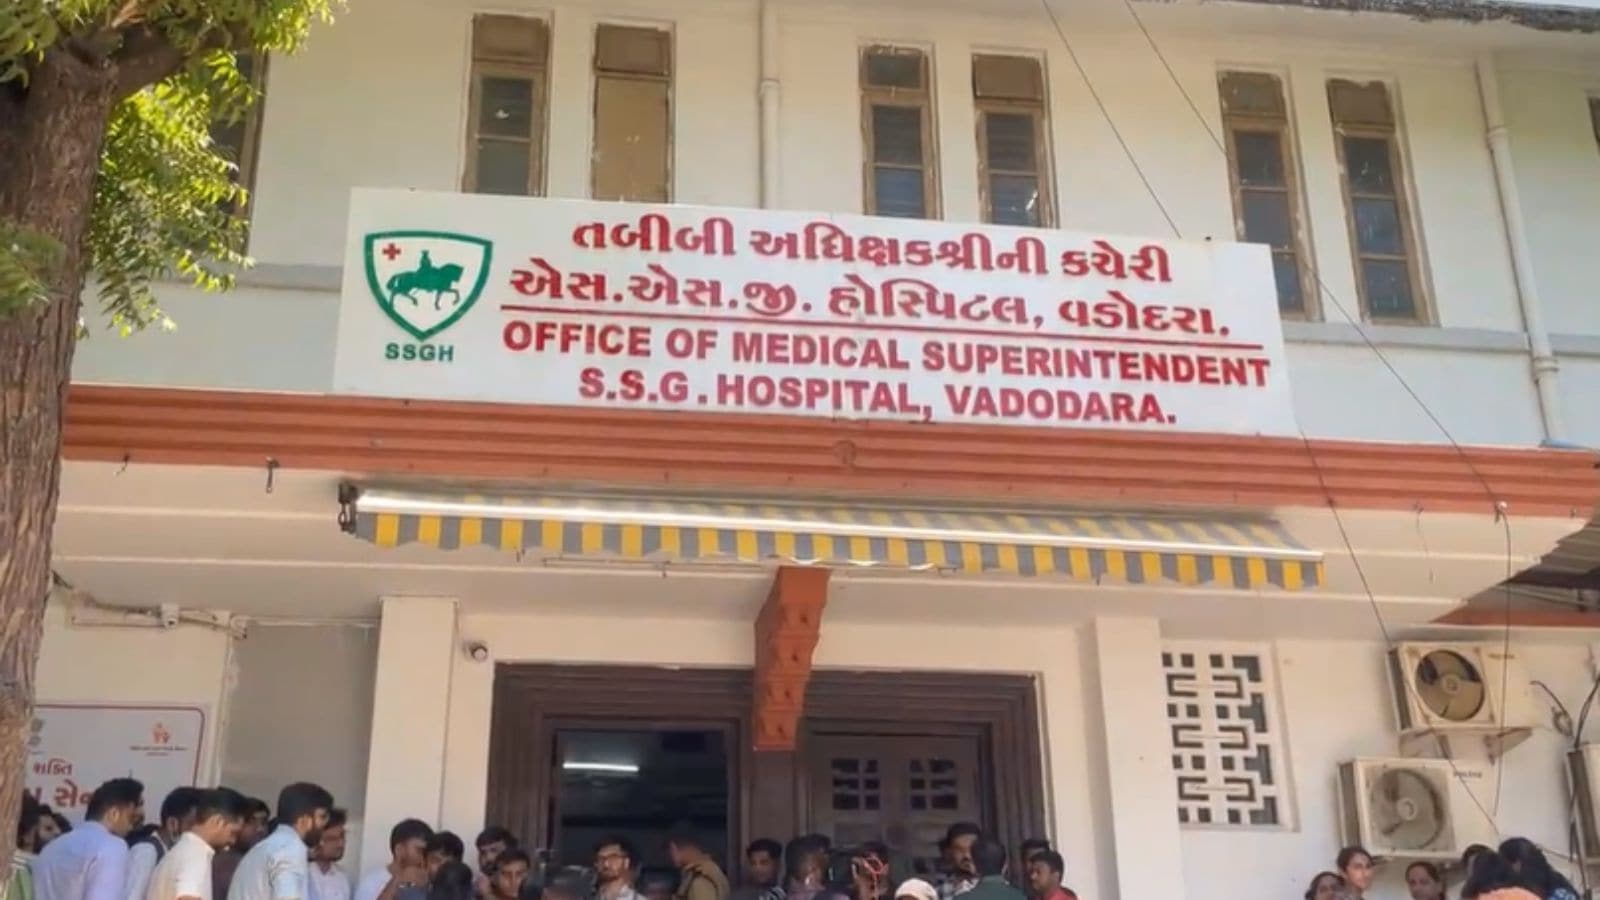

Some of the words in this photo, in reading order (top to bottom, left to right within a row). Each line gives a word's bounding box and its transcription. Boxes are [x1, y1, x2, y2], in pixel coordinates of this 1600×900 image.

[571, 213, 735, 258] તબીબી
[749, 221, 1048, 275] અધિક્ષકશ્રીની
[1060, 240, 1171, 283] કચેરી
[828, 274, 1044, 329] હોસ્પિટલ,
[1058, 290, 1230, 338] વડોદરા.
[385, 343, 455, 363] SSGH
[502, 320, 651, 358] OFFICE
[666, 329, 718, 360] OF
[732, 332, 909, 370] MEDICAL
[922, 341, 1270, 387] SUPERINTENDENT
[716, 374, 933, 421] HOSPITAL,
[945, 385, 1177, 425] VADODARA.
